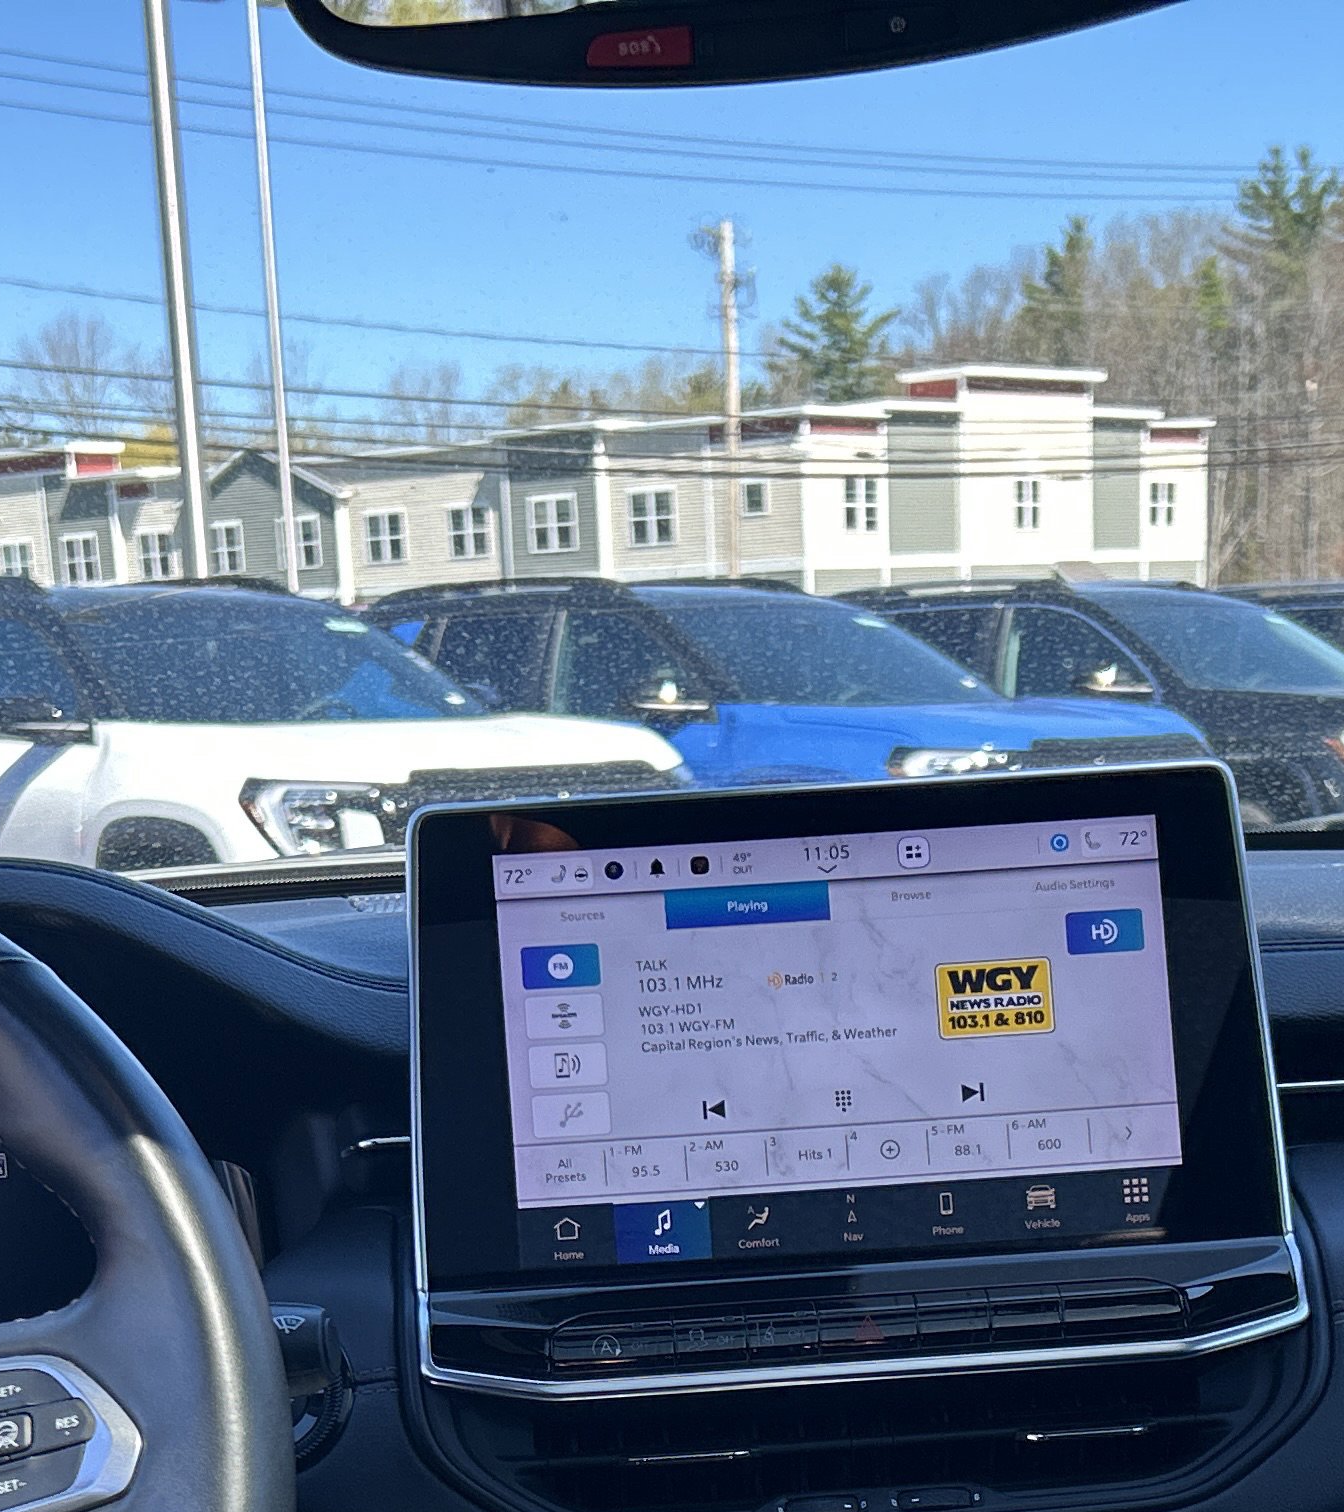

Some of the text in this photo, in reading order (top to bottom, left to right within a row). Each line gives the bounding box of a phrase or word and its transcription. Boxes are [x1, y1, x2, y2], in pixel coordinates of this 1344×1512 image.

[1119, 830, 1148, 846] 72°
[803, 844, 850, 861] 11:05
[503, 867, 533, 884] 72°
[1035, 877, 1115, 892] Audio Settings
[891, 889, 931, 902] Browse
[727, 900, 768, 914] Playing
[560, 910, 605, 923] Sources
[552, 961, 569, 972] FM
[635, 959, 668, 972] TALK
[639, 975, 724, 993] 103.1 MHz
[784, 973, 814, 986] Radio
[947, 964, 1039, 994] WGY
[949, 994, 1042, 1012] NEWS RADIO
[638, 1003, 703, 1018] WGY-HD1
[948, 1010, 1045, 1030] 103.1 & 810
[641, 1019, 735, 1035] 103.1 WGY-FM
[641, 1026, 898, 1056] Capital Region's News, Traffic, & Weather
[769, 1137, 777, 1147] 3
[849, 1131, 858, 1142] 4
[954, 1144, 982, 1156] 88.1
[1037, 1138, 1062, 1151] 600
[798, 1149, 823, 1161] Hits
[557, 1158, 573, 1170] All
[715, 1160, 739, 1172] 530
[545, 1170, 586, 1183] Presets
[631, 1165, 660, 1178] 95.5
[1025, 1217, 1061, 1230] Vehicle
[1125, 1212, 1151, 1225] Apps
[843, 1232, 864, 1242] Nav
[932, 1225, 964, 1236] Phone
[738, 1236, 780, 1250] Comfort
[554, 1250, 584, 1261] Home
[648, 1244, 680, 1256] Media
[55, 1414, 80, 1430] RES
